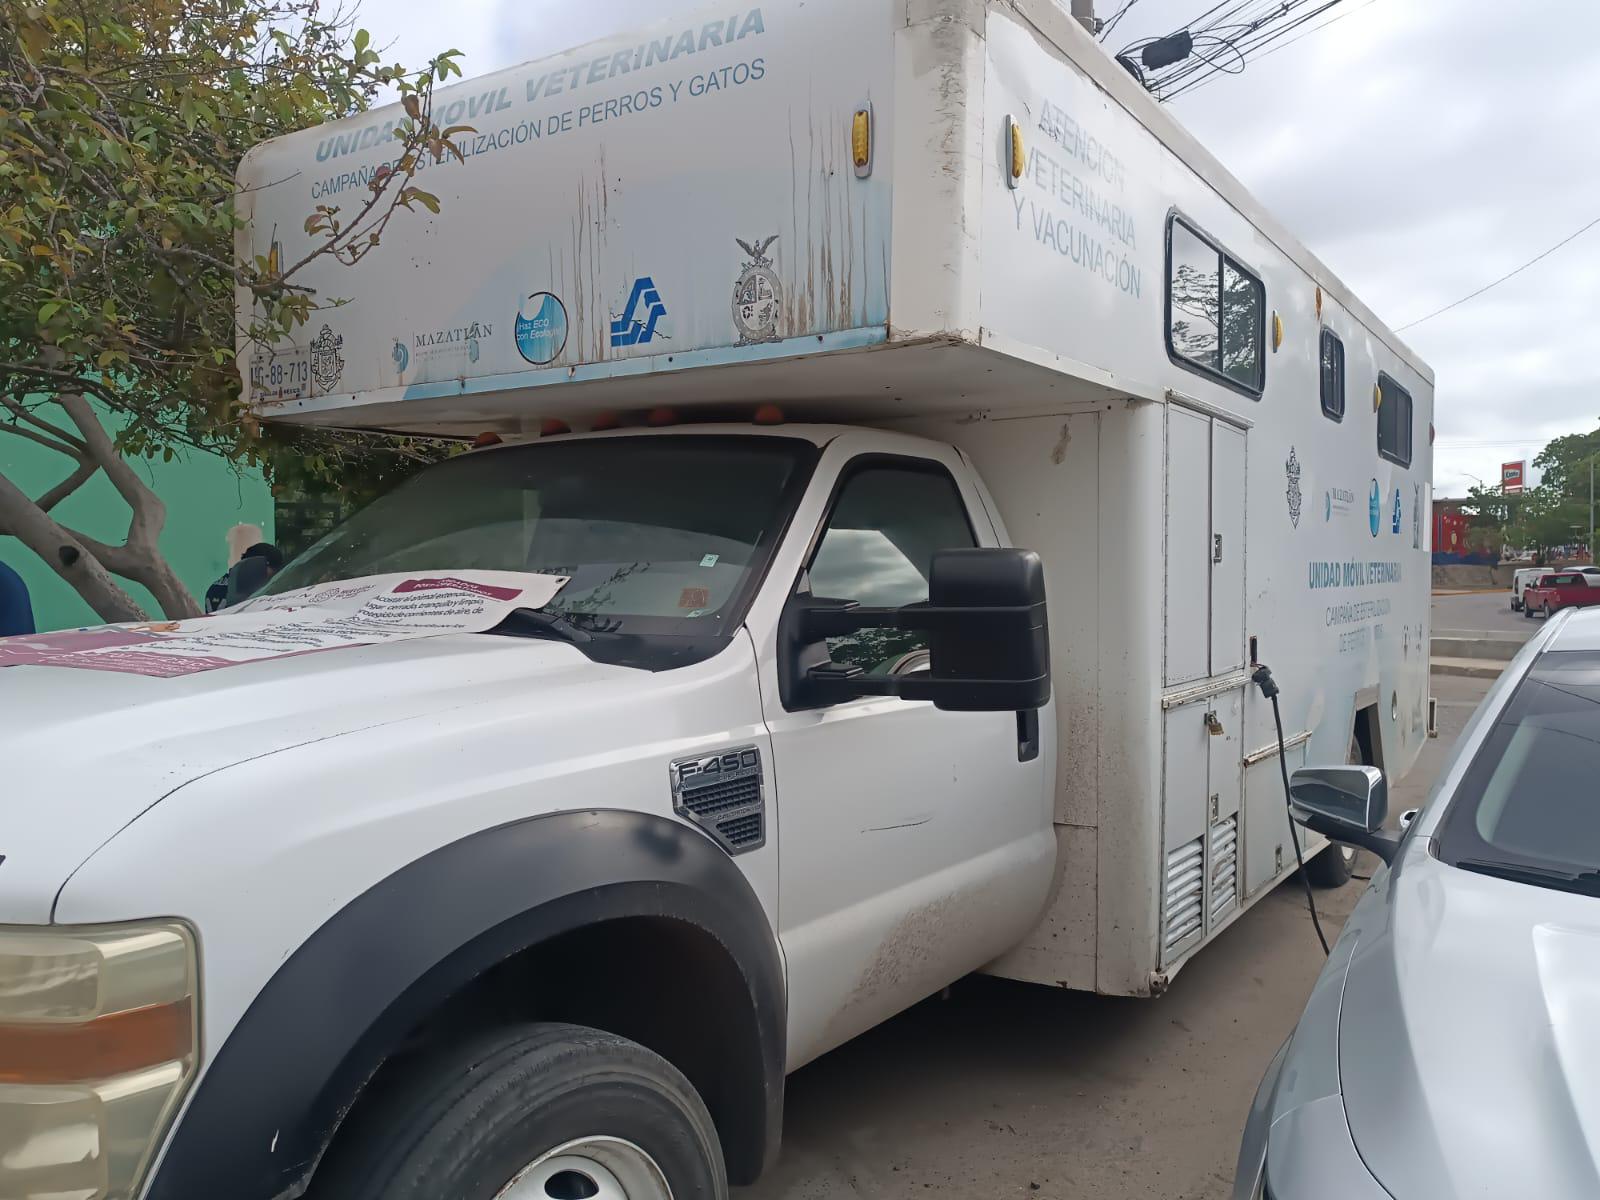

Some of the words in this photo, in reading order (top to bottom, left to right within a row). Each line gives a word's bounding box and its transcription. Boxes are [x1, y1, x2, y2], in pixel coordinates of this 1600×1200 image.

[526, 8, 765, 102] VETERINARIA
[311, 163, 377, 199] CAMPAÑA
[547, 111, 573, 135] DE
[578, 86, 662, 127] PERROS
[669, 80, 683, 102] Y
[689, 58, 765, 97] GATOS
[1012, 190, 1025, 231] Y
[1031, 200, 1141, 298] VACUNACIÓN
[1023, 146, 1137, 250] VETERINARIA
[533, 318, 550, 329] ECO
[1309, 561, 1341, 589] UNIDAD
[1343, 556, 1365, 587] MÓVIL
[677, 750, 758, 784] F-450
